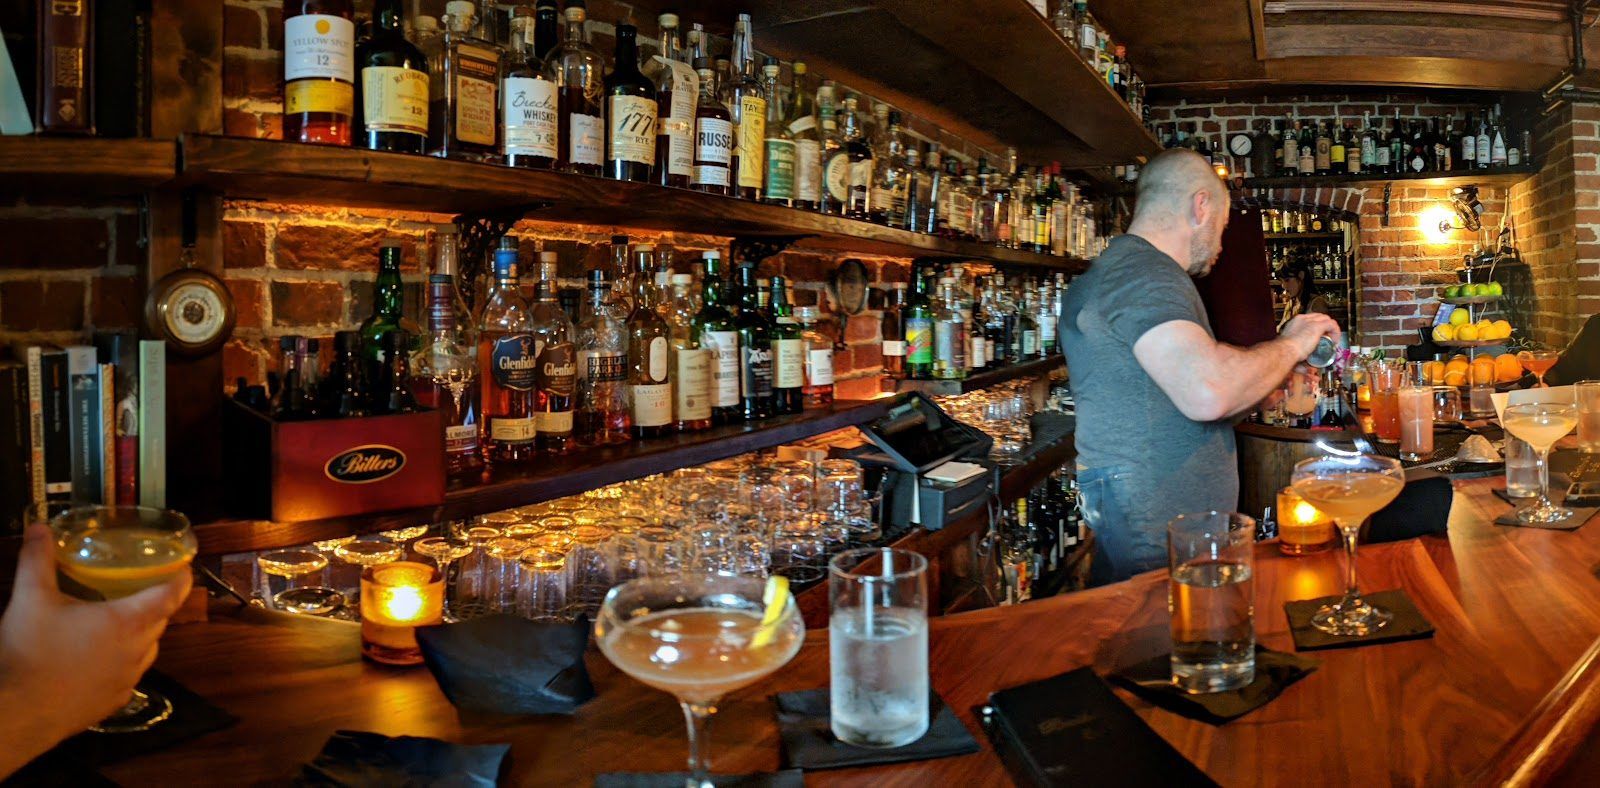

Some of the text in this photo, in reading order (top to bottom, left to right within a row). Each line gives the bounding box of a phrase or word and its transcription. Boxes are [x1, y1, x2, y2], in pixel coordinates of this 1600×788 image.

[293, 37, 328, 47] YELLOW
[316, 54, 329, 66] 12
[412, 105, 423, 116] 12
[635, 137, 650, 145] RYE
[337, 453, 398, 475] Bitters
